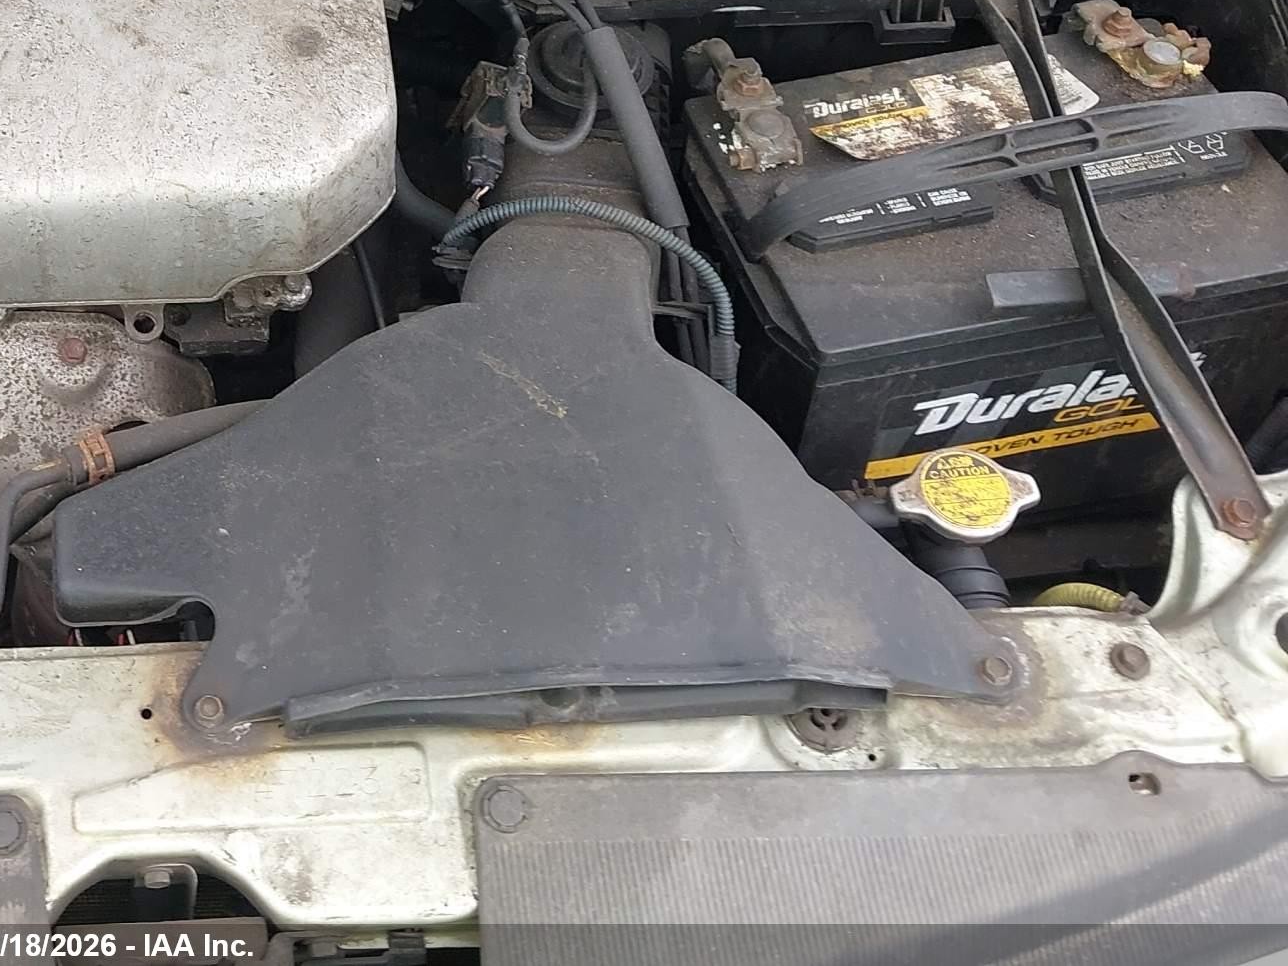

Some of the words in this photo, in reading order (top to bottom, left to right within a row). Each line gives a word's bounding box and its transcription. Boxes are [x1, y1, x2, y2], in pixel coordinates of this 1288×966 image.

[1054, 398, 1145, 423] GOL
[1053, 418, 1144, 441] TOUGH
[929, 465, 990, 479] CAUTION
